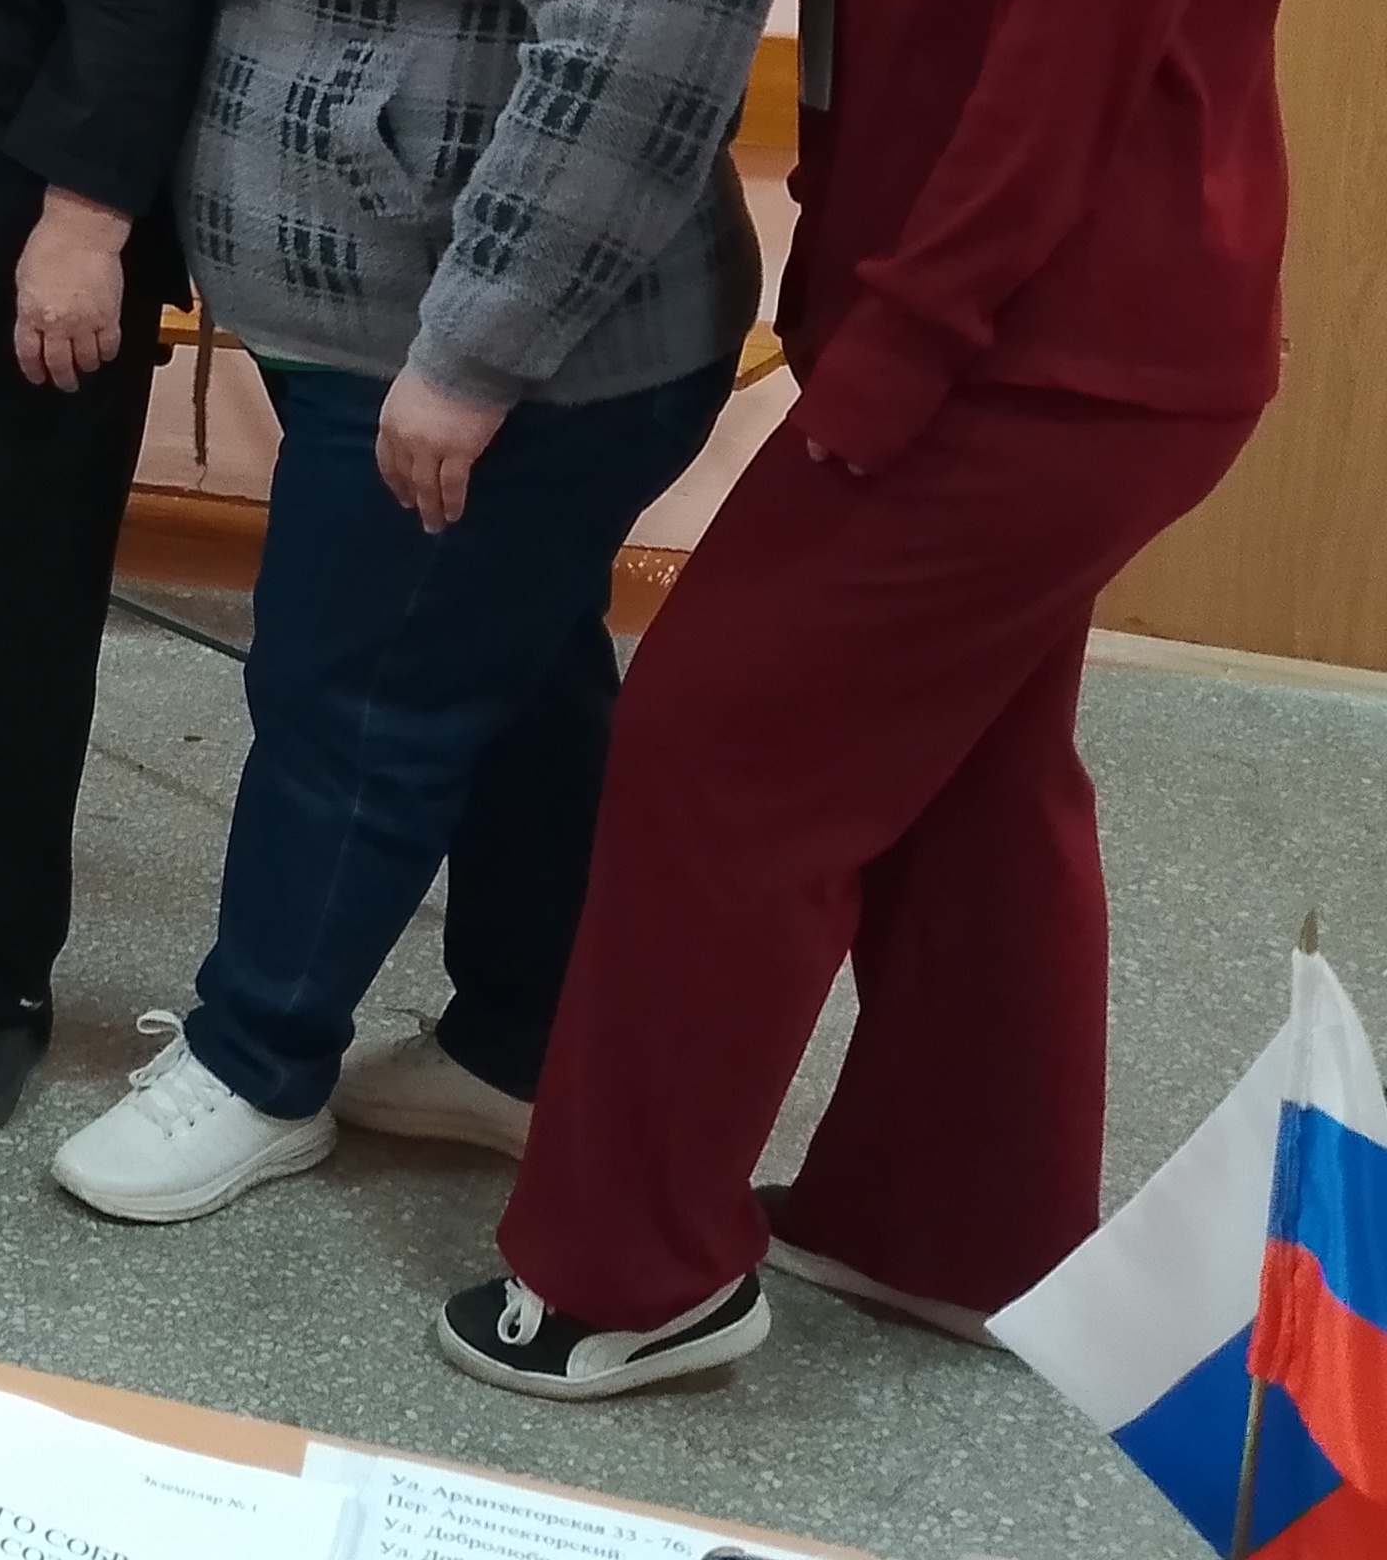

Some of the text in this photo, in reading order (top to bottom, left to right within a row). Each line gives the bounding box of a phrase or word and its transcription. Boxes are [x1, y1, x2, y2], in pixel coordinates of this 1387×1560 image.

[384, 1516, 417, 1535] Ул.
[391, 1474, 424, 1492] Ул.
[432, 1485, 605, 1536] Архитекторская
[613, 1526, 637, 1542] 33
